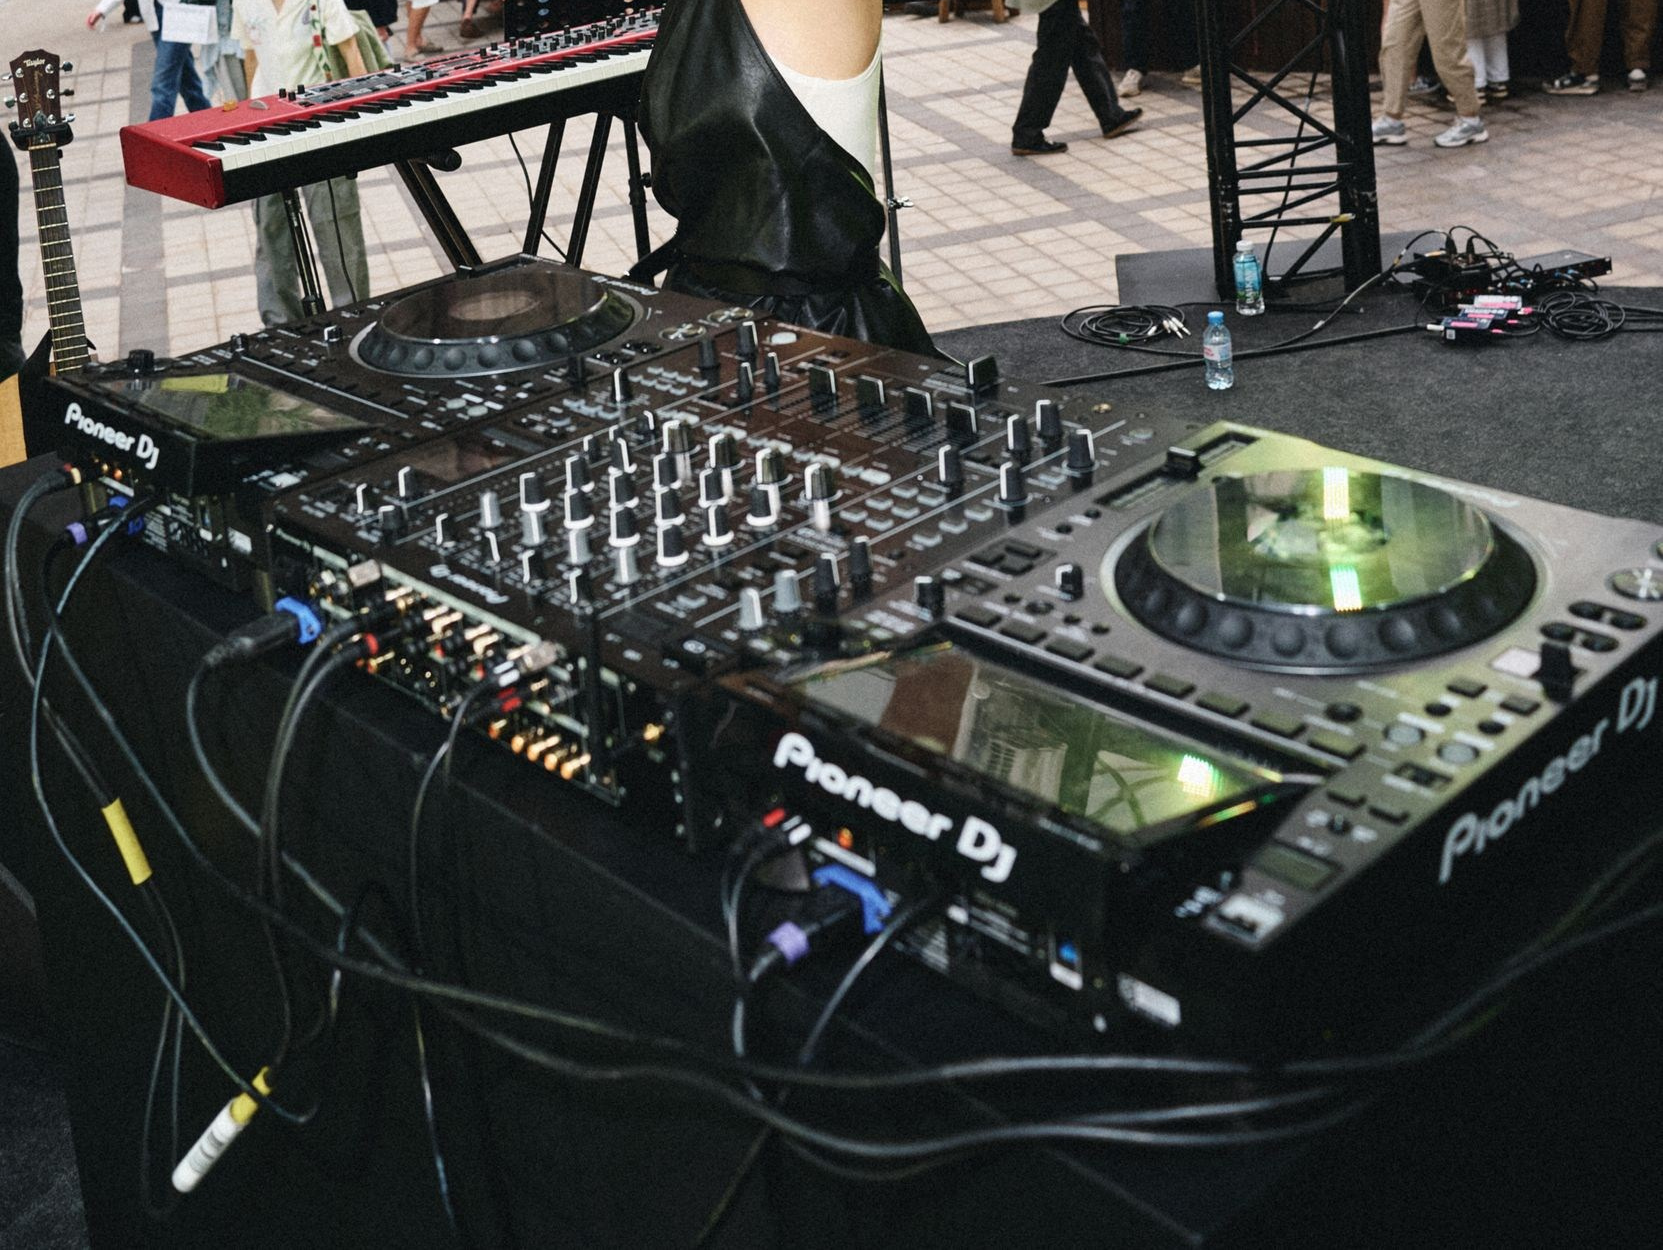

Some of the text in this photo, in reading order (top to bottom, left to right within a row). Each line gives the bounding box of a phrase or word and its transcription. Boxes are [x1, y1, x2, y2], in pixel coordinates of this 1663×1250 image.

[64, 402, 135, 451] Pioneer
[773, 732, 953, 841] Pioneer
[1438, 717, 1610, 885] Pioneer
